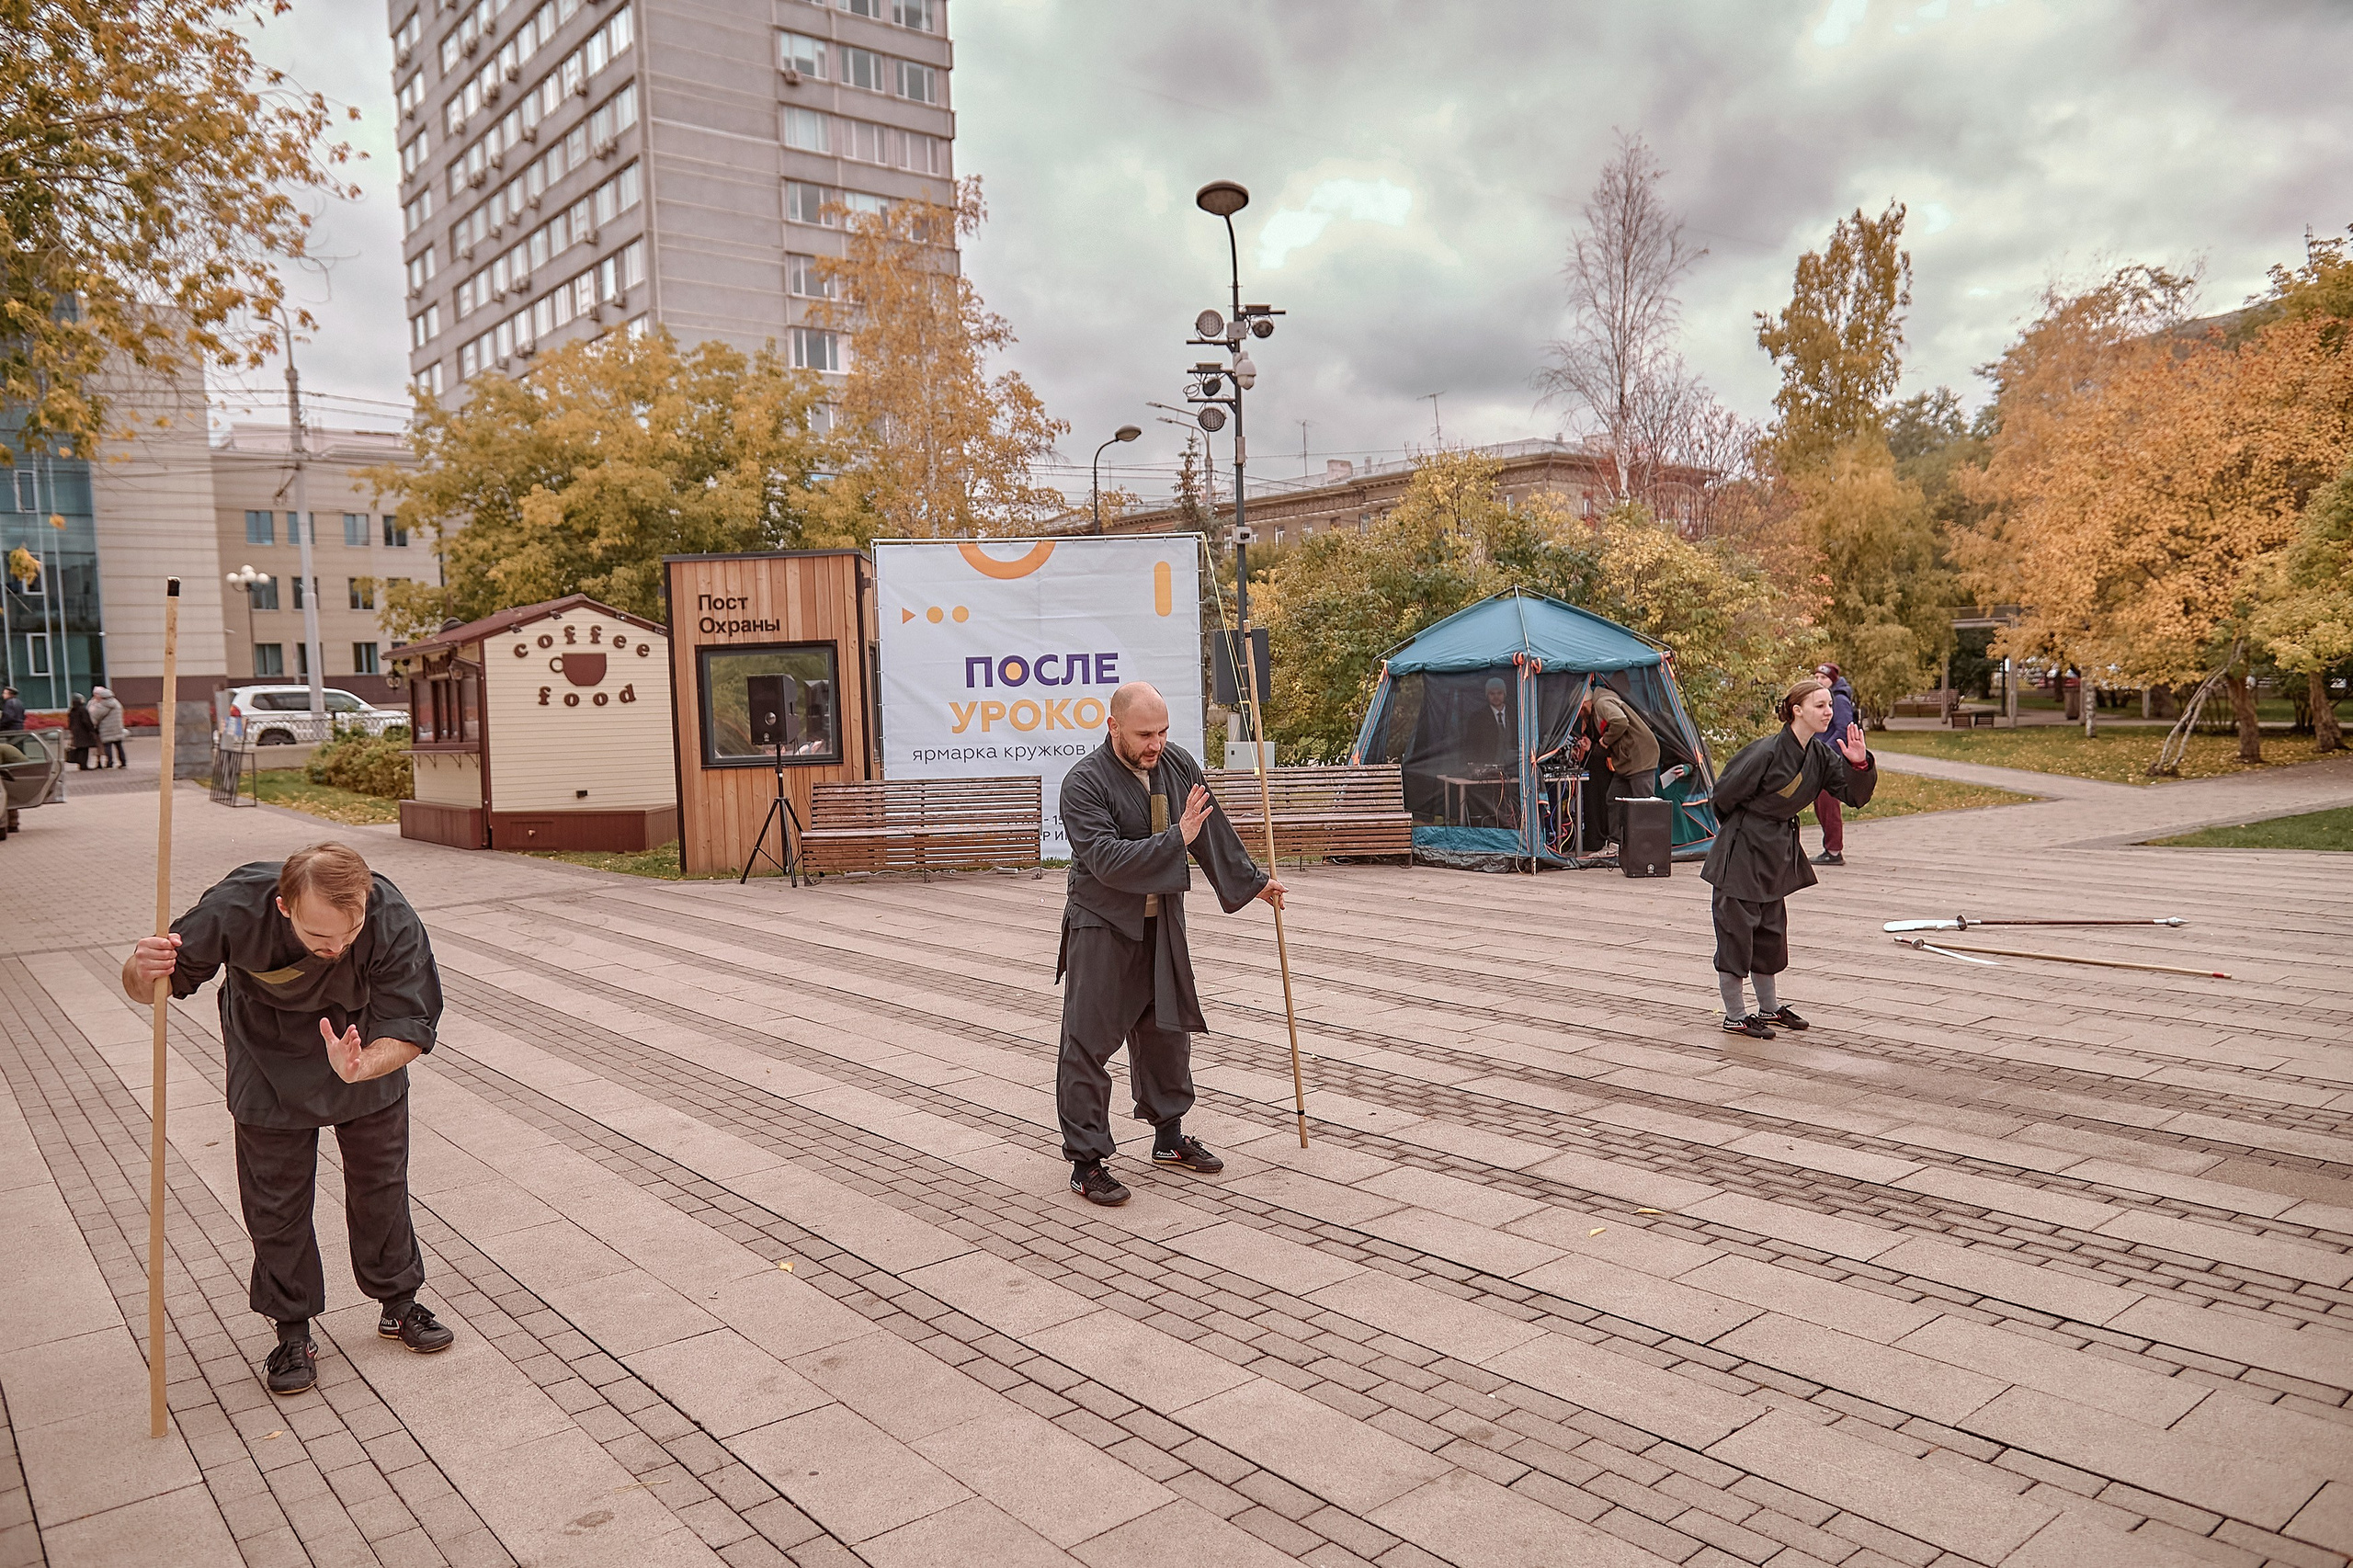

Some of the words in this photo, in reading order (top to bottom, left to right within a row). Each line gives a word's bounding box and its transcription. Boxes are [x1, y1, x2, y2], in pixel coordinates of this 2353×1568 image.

[698, 594, 748, 611] Пост
[699, 617, 780, 636] Охраны
[514, 625, 650, 658] coffee
[965, 653, 1120, 687] ПОСЛЕ
[539, 684, 636, 707] food
[949, 697, 1110, 733] УРОКО
[912, 744, 997, 764] ярмарка
[1005, 744, 1086, 761] кружков
